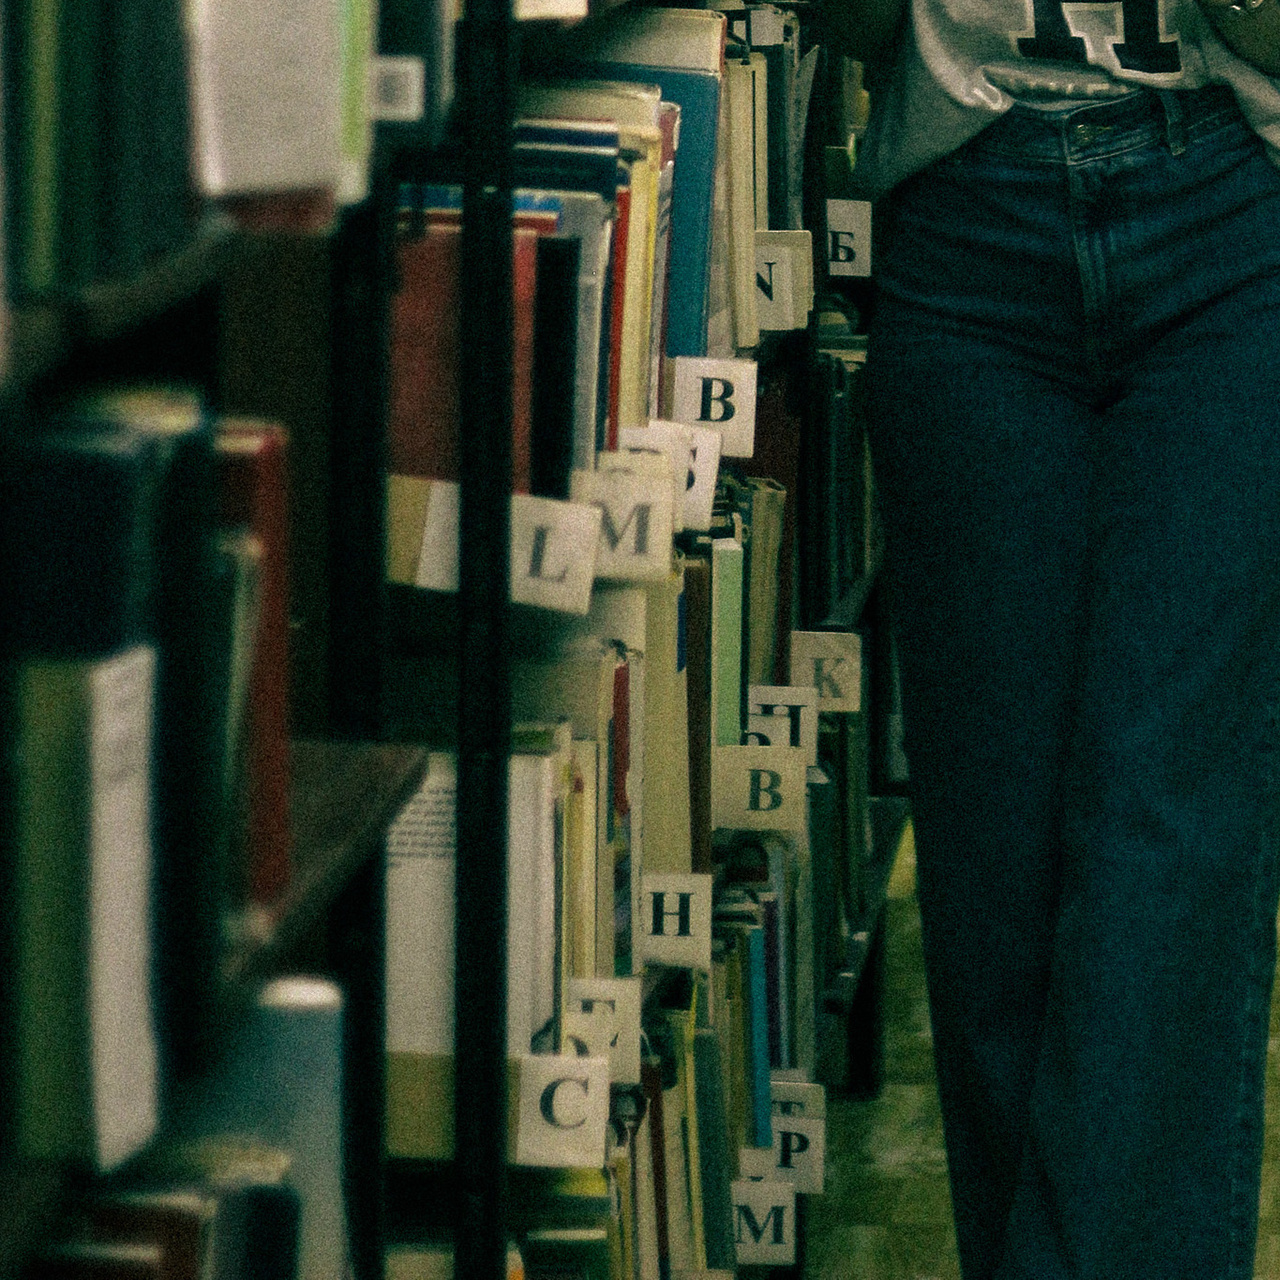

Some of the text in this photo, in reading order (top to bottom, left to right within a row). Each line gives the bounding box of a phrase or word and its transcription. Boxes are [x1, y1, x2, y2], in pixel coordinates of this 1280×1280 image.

[828, 230, 857, 263] Б
[526, 524, 570, 584] L
[539, 1077, 590, 1130] C
